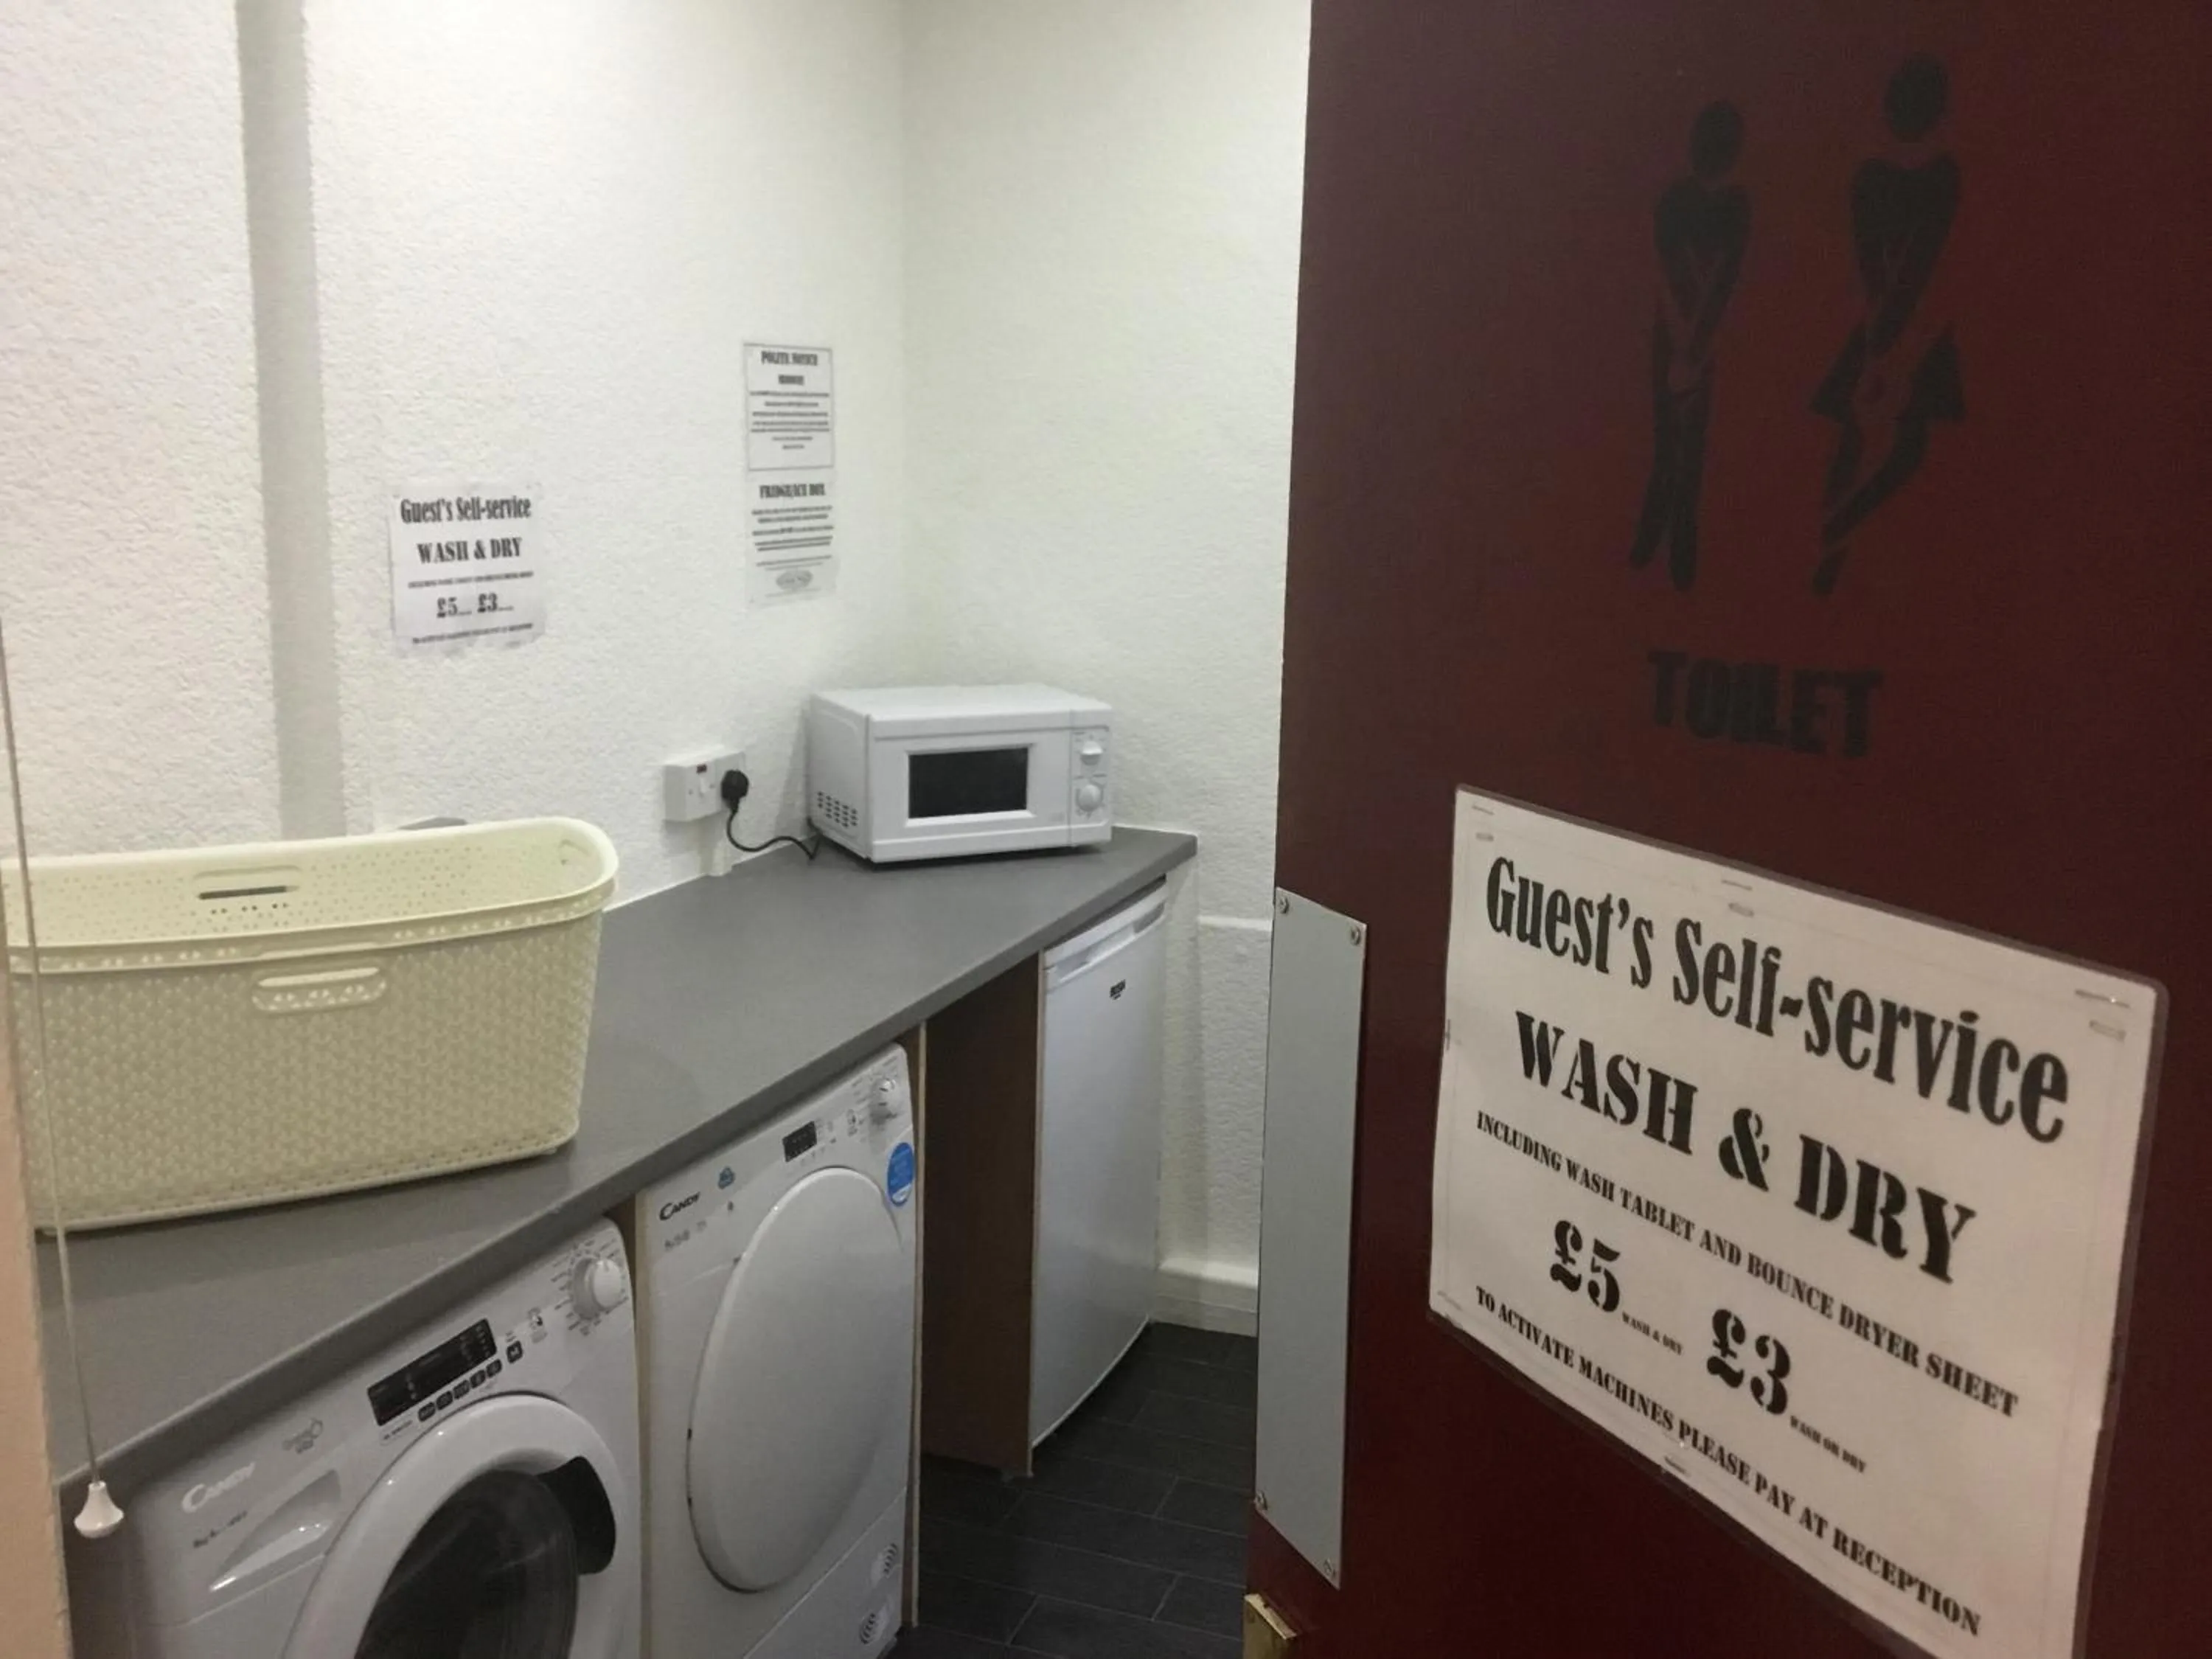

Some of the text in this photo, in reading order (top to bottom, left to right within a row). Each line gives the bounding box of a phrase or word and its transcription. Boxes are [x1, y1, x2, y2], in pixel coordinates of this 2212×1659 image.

[400, 495, 532, 524] Guest's Self-service
[417, 537, 522, 564] WASH & DRY
[437, 592, 498, 618] £5 £3
[1646, 650, 1884, 757] TOILET
[1487, 857, 2067, 1143] Guest's Self-service
[1516, 1012, 1975, 1283] WASH & DRY
[1478, 1111, 2017, 1416] INCLUDING WASH TABLET AND BOUNCE DRYER SHEET
[1551, 1221, 1620, 1312] £5
[1622, 1312, 1649, 1335] WASH
[1663, 1335, 1681, 1354] DRY
[1477, 1286, 1979, 1635] TO ACTIVATE MACHINES PLEASE PAY AT RECEPTION
[1707, 1310, 1865, 1472] £3 WASH OR DRY
